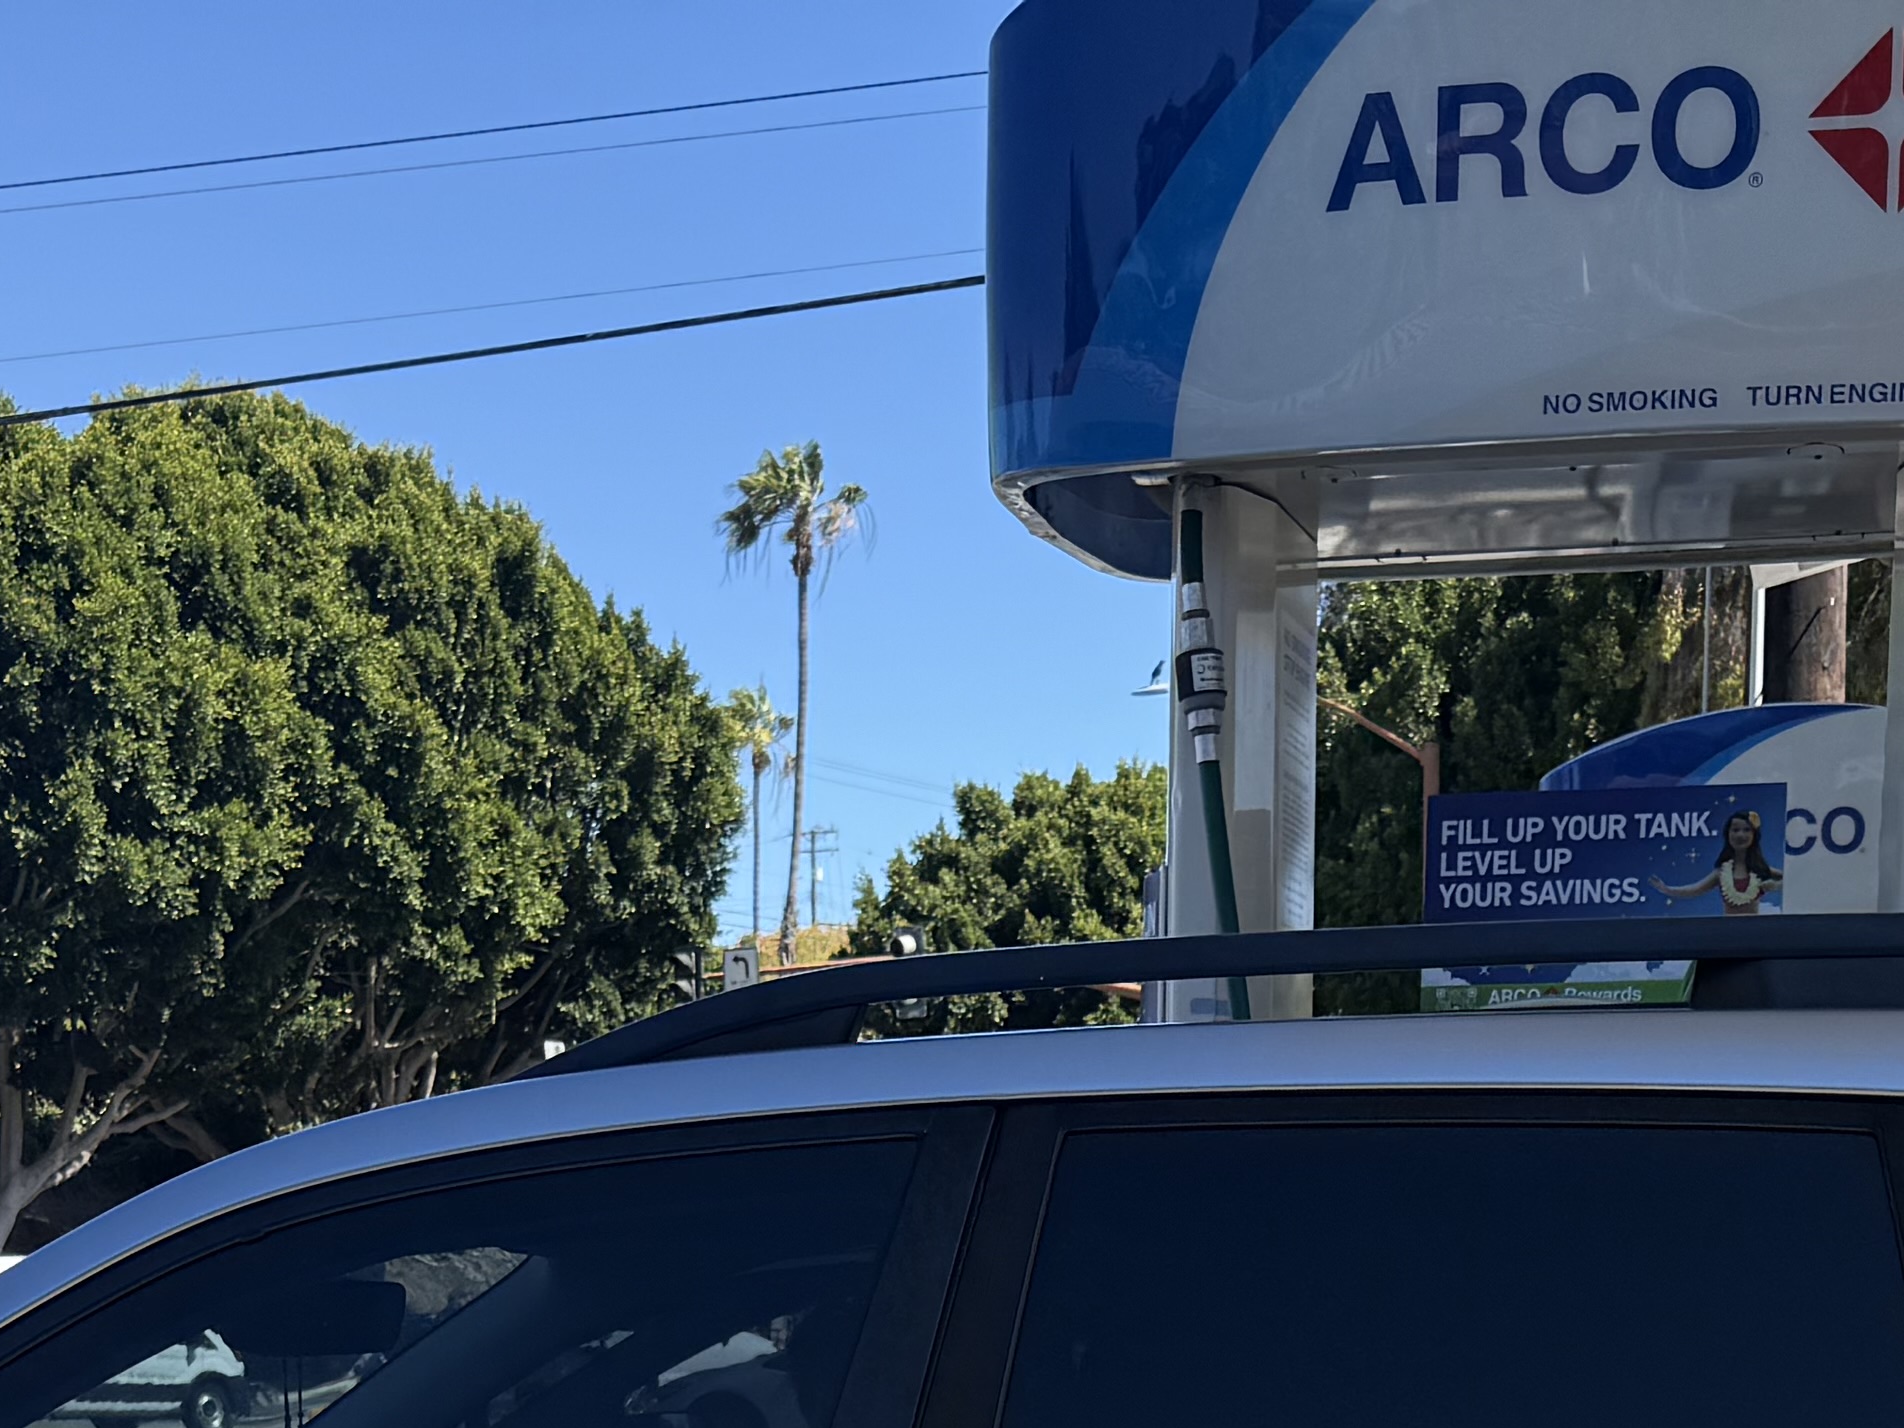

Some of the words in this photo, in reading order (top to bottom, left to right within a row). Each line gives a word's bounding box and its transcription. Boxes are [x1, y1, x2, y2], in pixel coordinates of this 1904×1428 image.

[1325, 65, 1760, 212] ARCO
[1542, 393, 1581, 415] NO
[1587, 388, 1718, 413] SMOKING
[1746, 385, 1823, 407] TURN
[1441, 818, 1498, 846] FILL
[1506, 816, 1544, 843] UP
[1551, 814, 1628, 841] YOUR
[1634, 809, 1718, 838] TANK.
[1440, 850, 1526, 877] LEVEL
[1534, 847, 1572, 875] UP
[1439, 882, 1511, 908] YOUR
[1520, 878, 1646, 905] SAVINGS.
